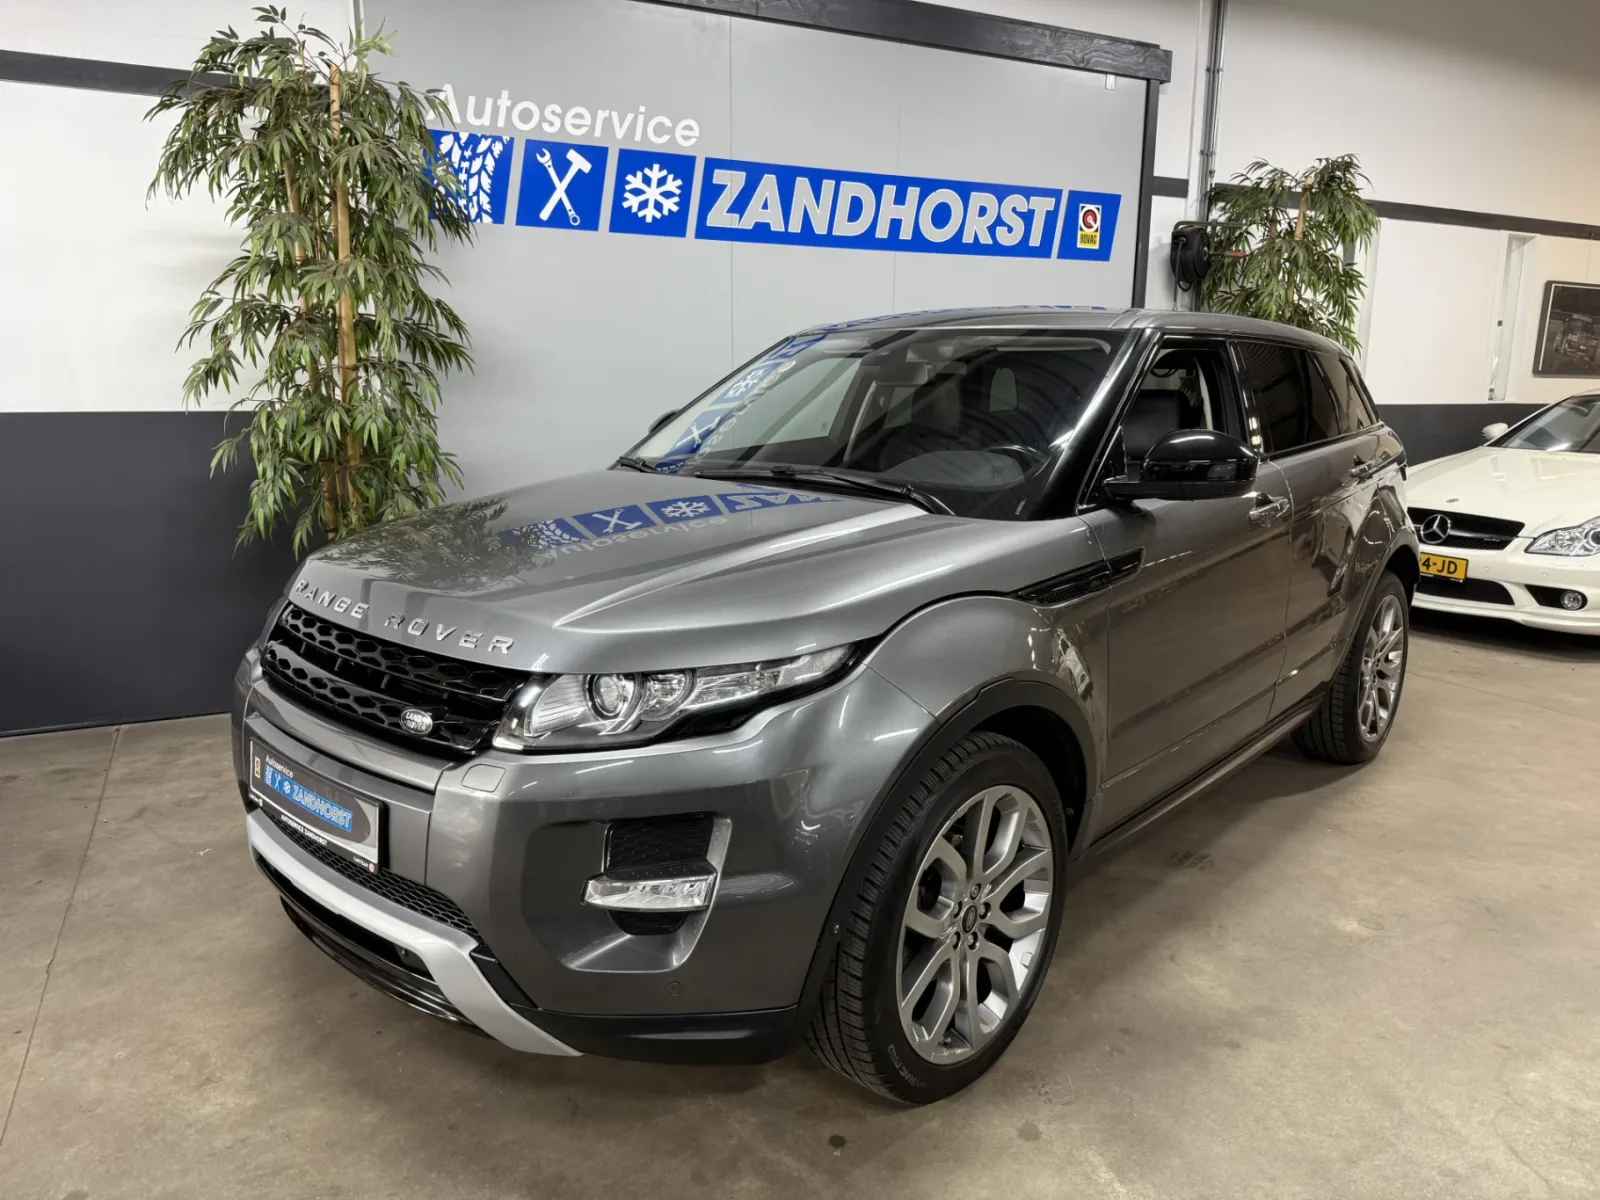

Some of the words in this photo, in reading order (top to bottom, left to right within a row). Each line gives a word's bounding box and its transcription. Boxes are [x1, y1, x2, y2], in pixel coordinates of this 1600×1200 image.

[426, 83, 700, 147] Autoservice
[706, 169, 1057, 247] ZANDHORST
[1420, 556, 1458, 575] 4-JD
[294, 578, 370, 619] RANGE
[384, 611, 515, 654] ROVER
[406, 719, 427, 732] ROVER
[265, 755, 293, 778] Autoservice
[291, 785, 352, 828] ZANDHORST
